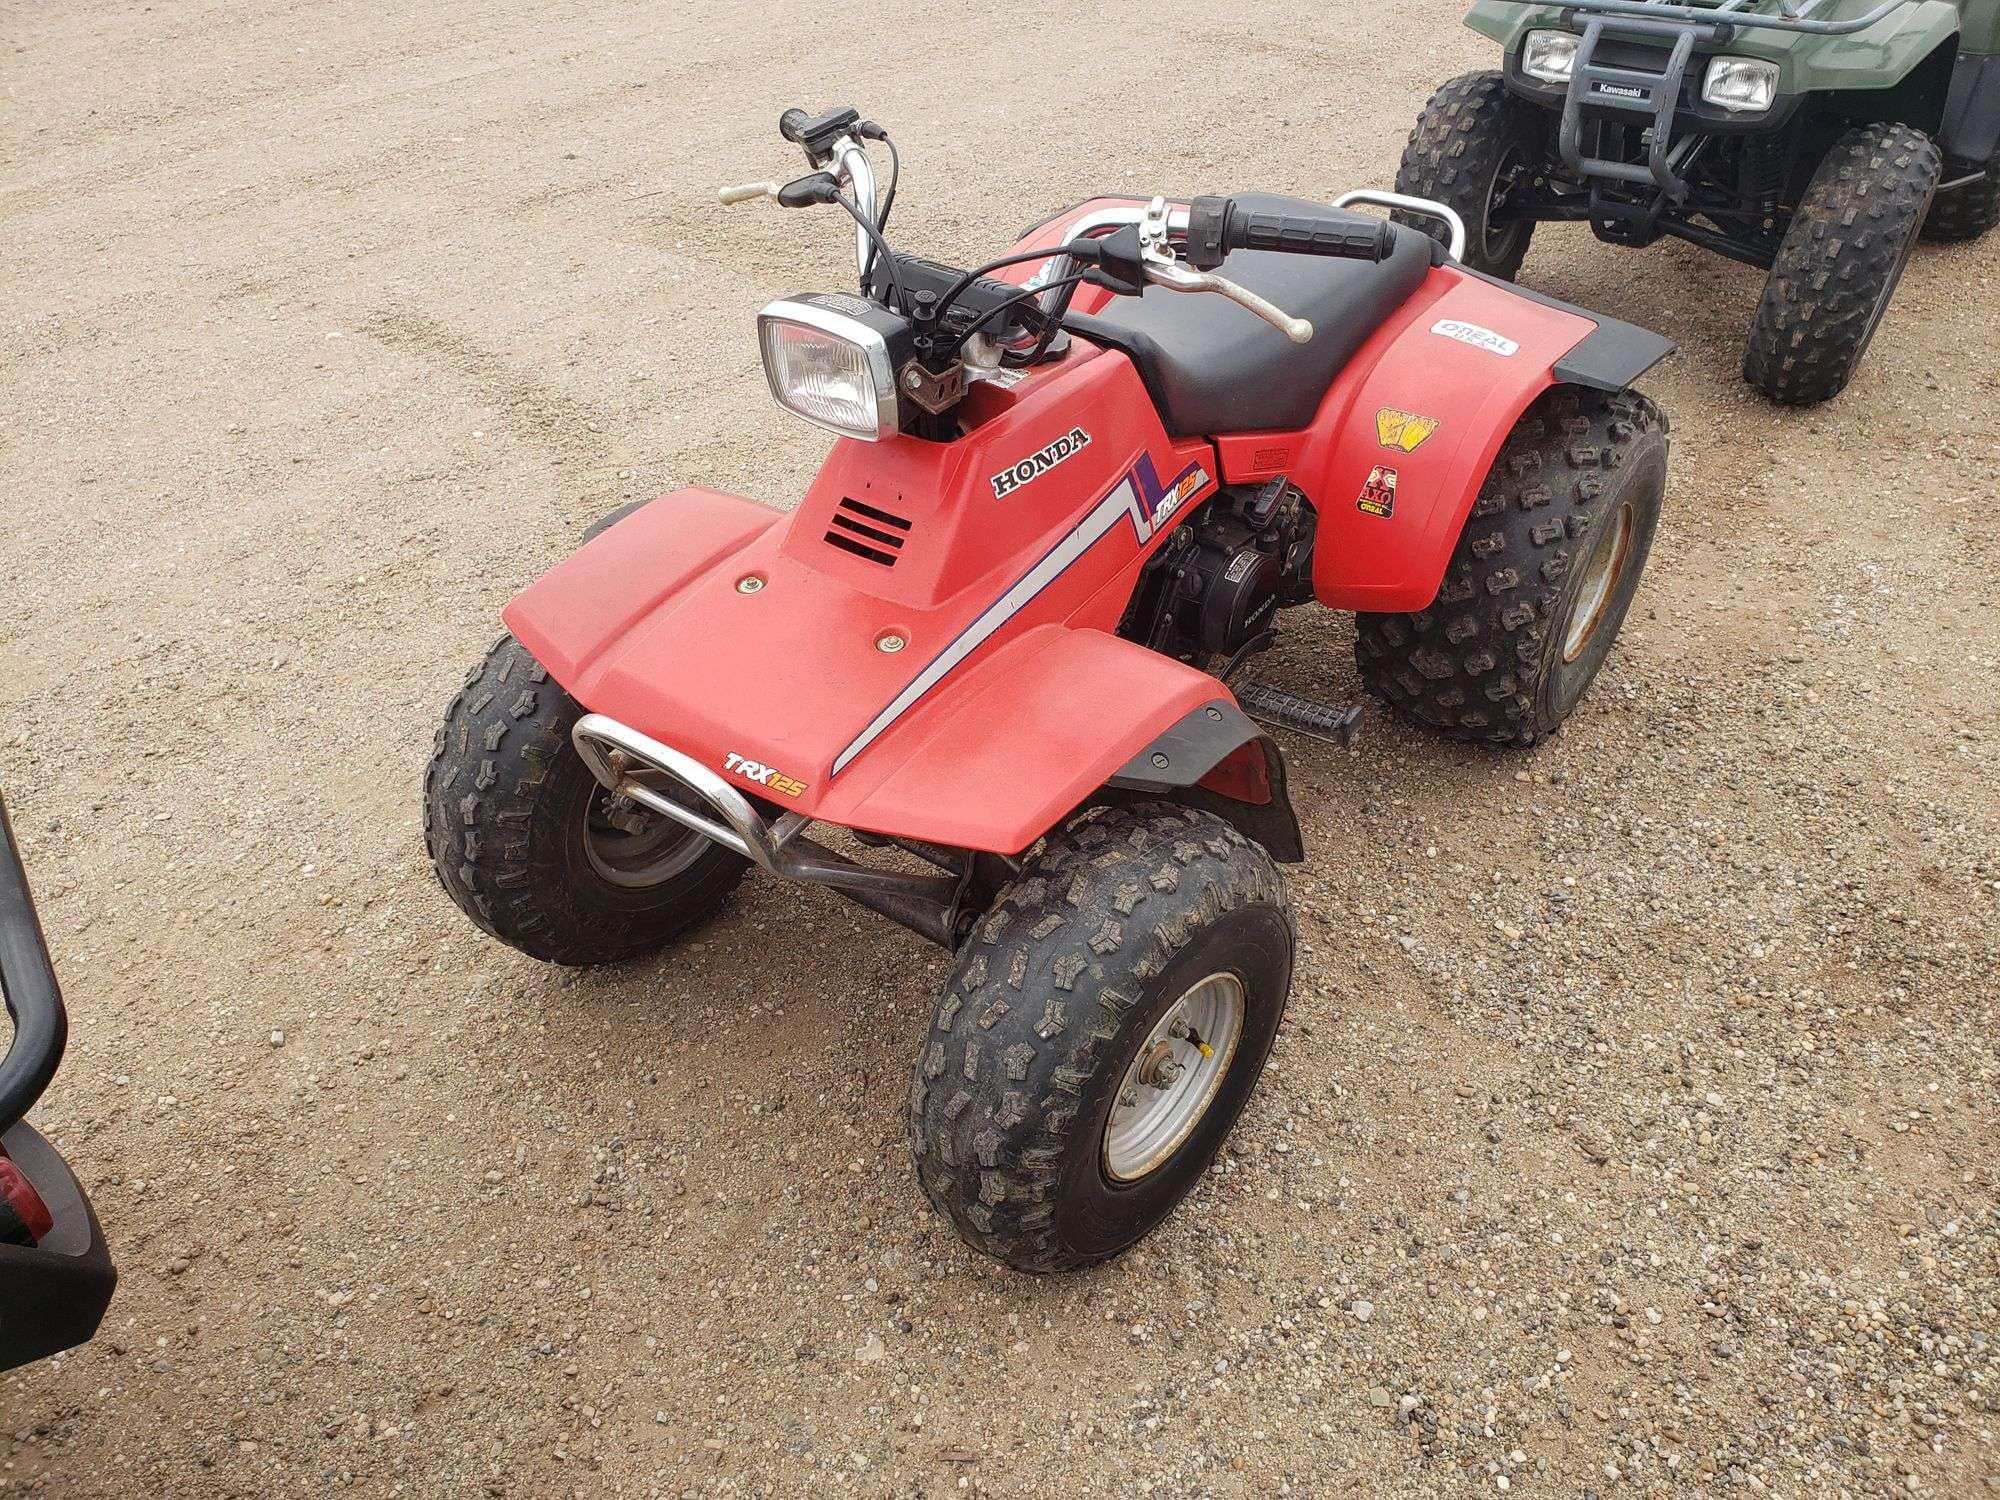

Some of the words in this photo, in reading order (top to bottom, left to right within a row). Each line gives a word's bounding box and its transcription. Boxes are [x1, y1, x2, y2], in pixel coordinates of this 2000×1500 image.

[1599, 83, 1641, 98] Kawasaki
[991, 427, 1090, 498] HONDA
[1155, 469, 1198, 523] TRX125
[722, 751, 809, 799] TRX125
